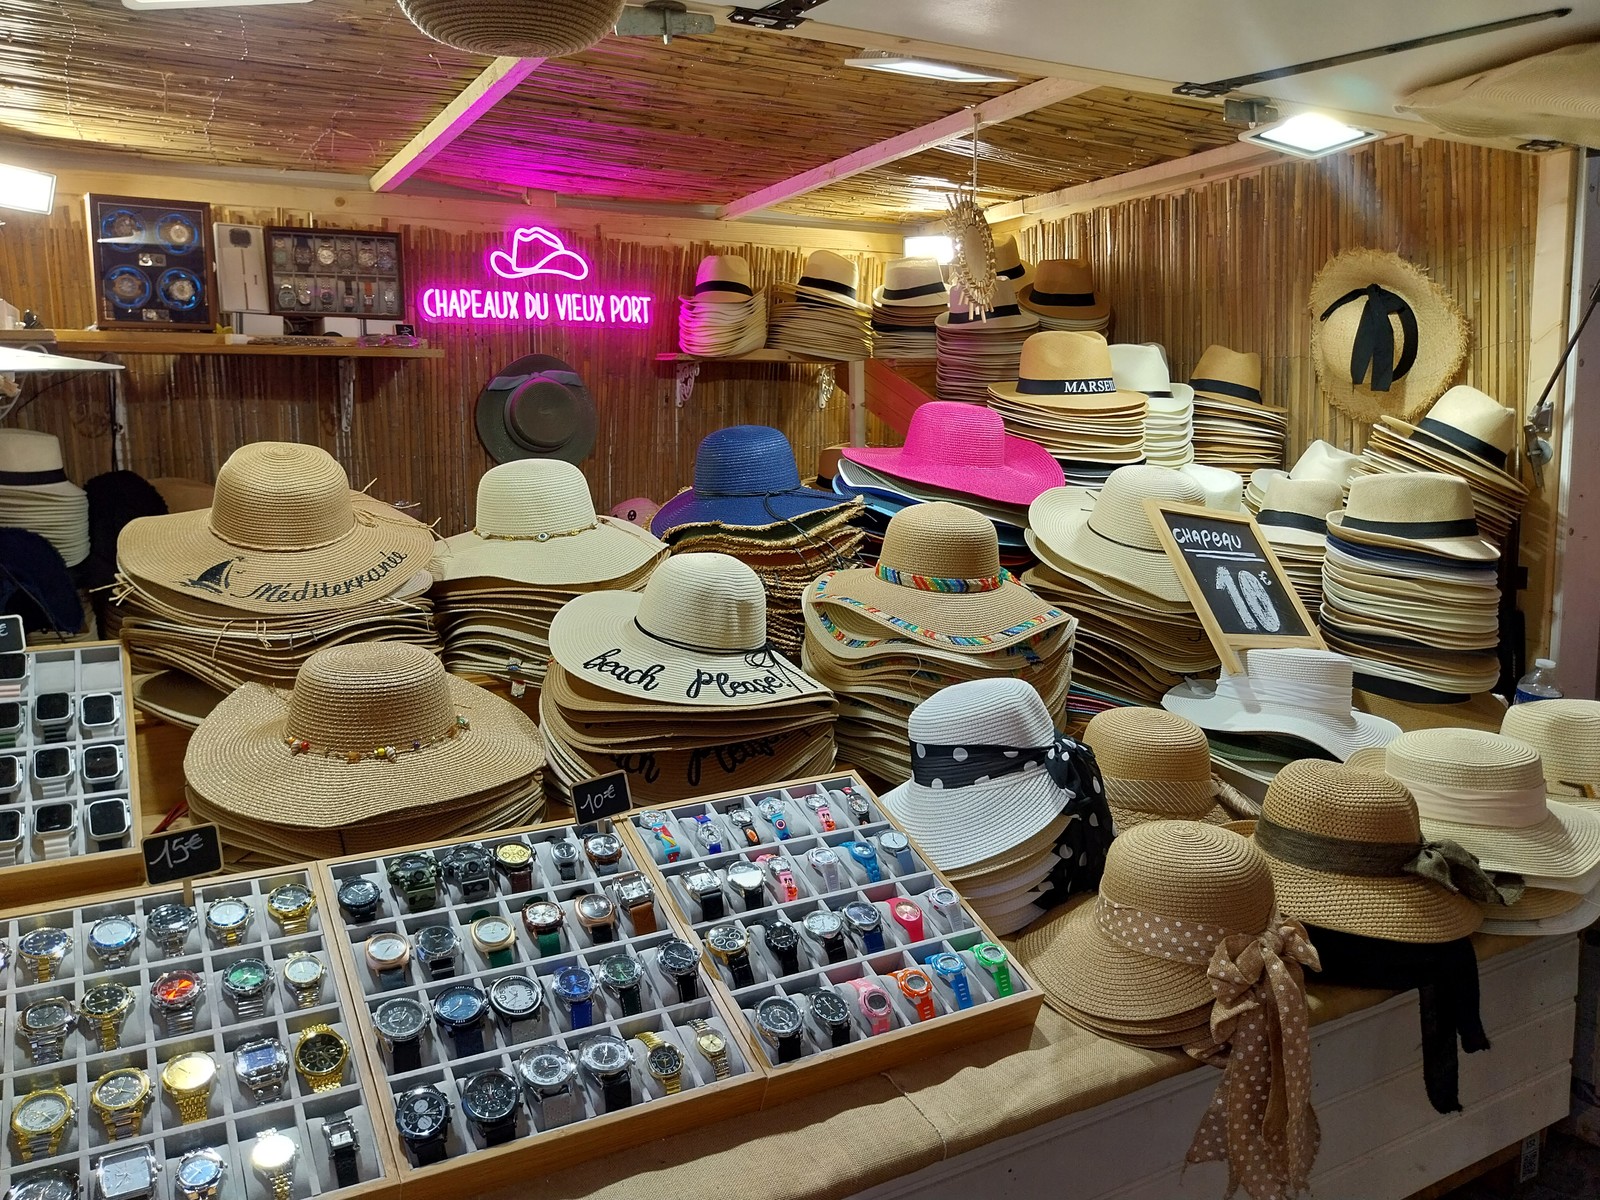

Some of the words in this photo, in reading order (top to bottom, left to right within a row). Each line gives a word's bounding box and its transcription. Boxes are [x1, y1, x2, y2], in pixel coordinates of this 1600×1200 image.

[423, 288, 519, 319] CHAPEAUX
[524, 291, 549, 320] DU
[554, 293, 605, 323] VIEUX
[610, 295, 652, 324] PORT
[583, 648, 666, 692] beach
[580, 784, 616, 814] 10€
[149, 833, 204, 869] 15€
